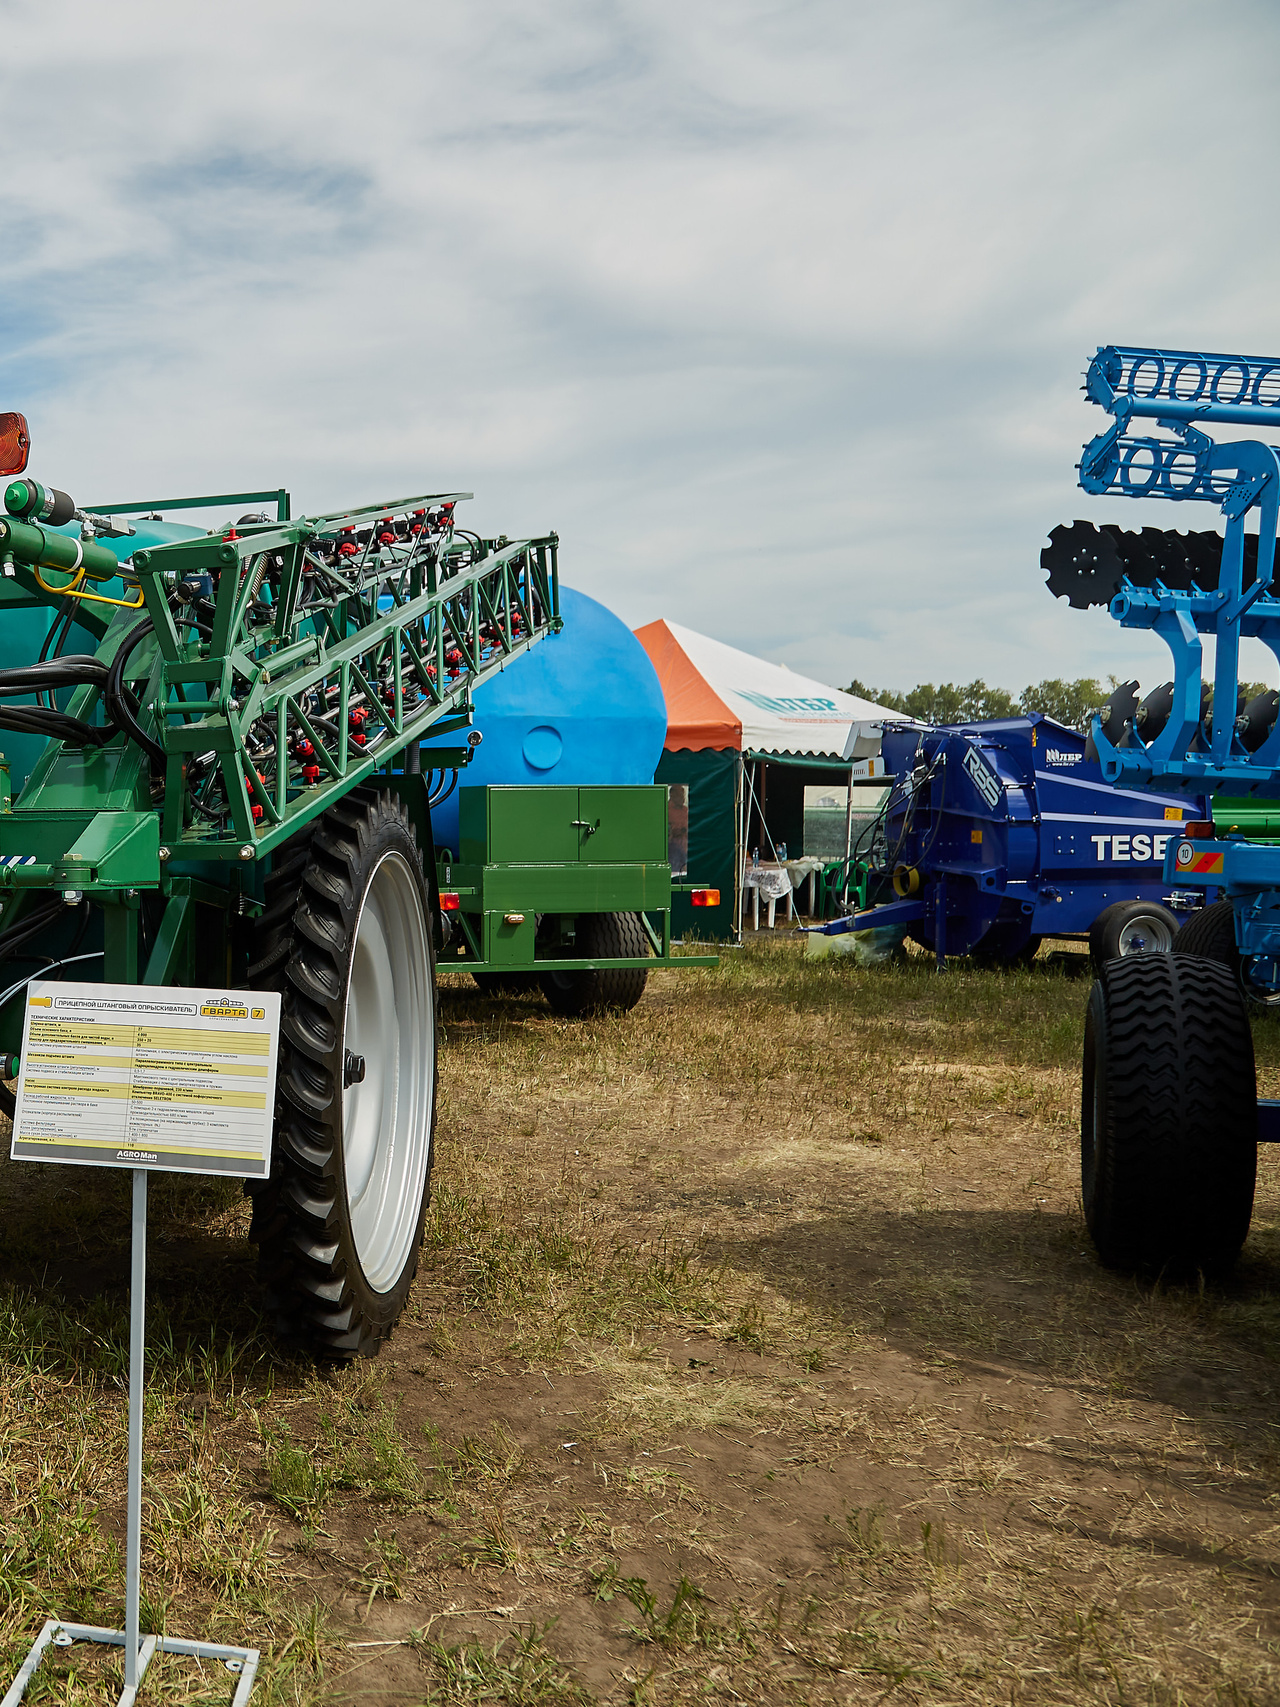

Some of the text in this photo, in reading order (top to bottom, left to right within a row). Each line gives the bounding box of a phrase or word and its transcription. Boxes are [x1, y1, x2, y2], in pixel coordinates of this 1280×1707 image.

[775, 698, 839, 711] ЛБР
[1060, 753, 1082, 762] ЛБР
[1091, 834, 1185, 861] TESE
[1182, 849, 1189, 858] 10
[203, 1007, 261, 1018] ГВАРТА 7
